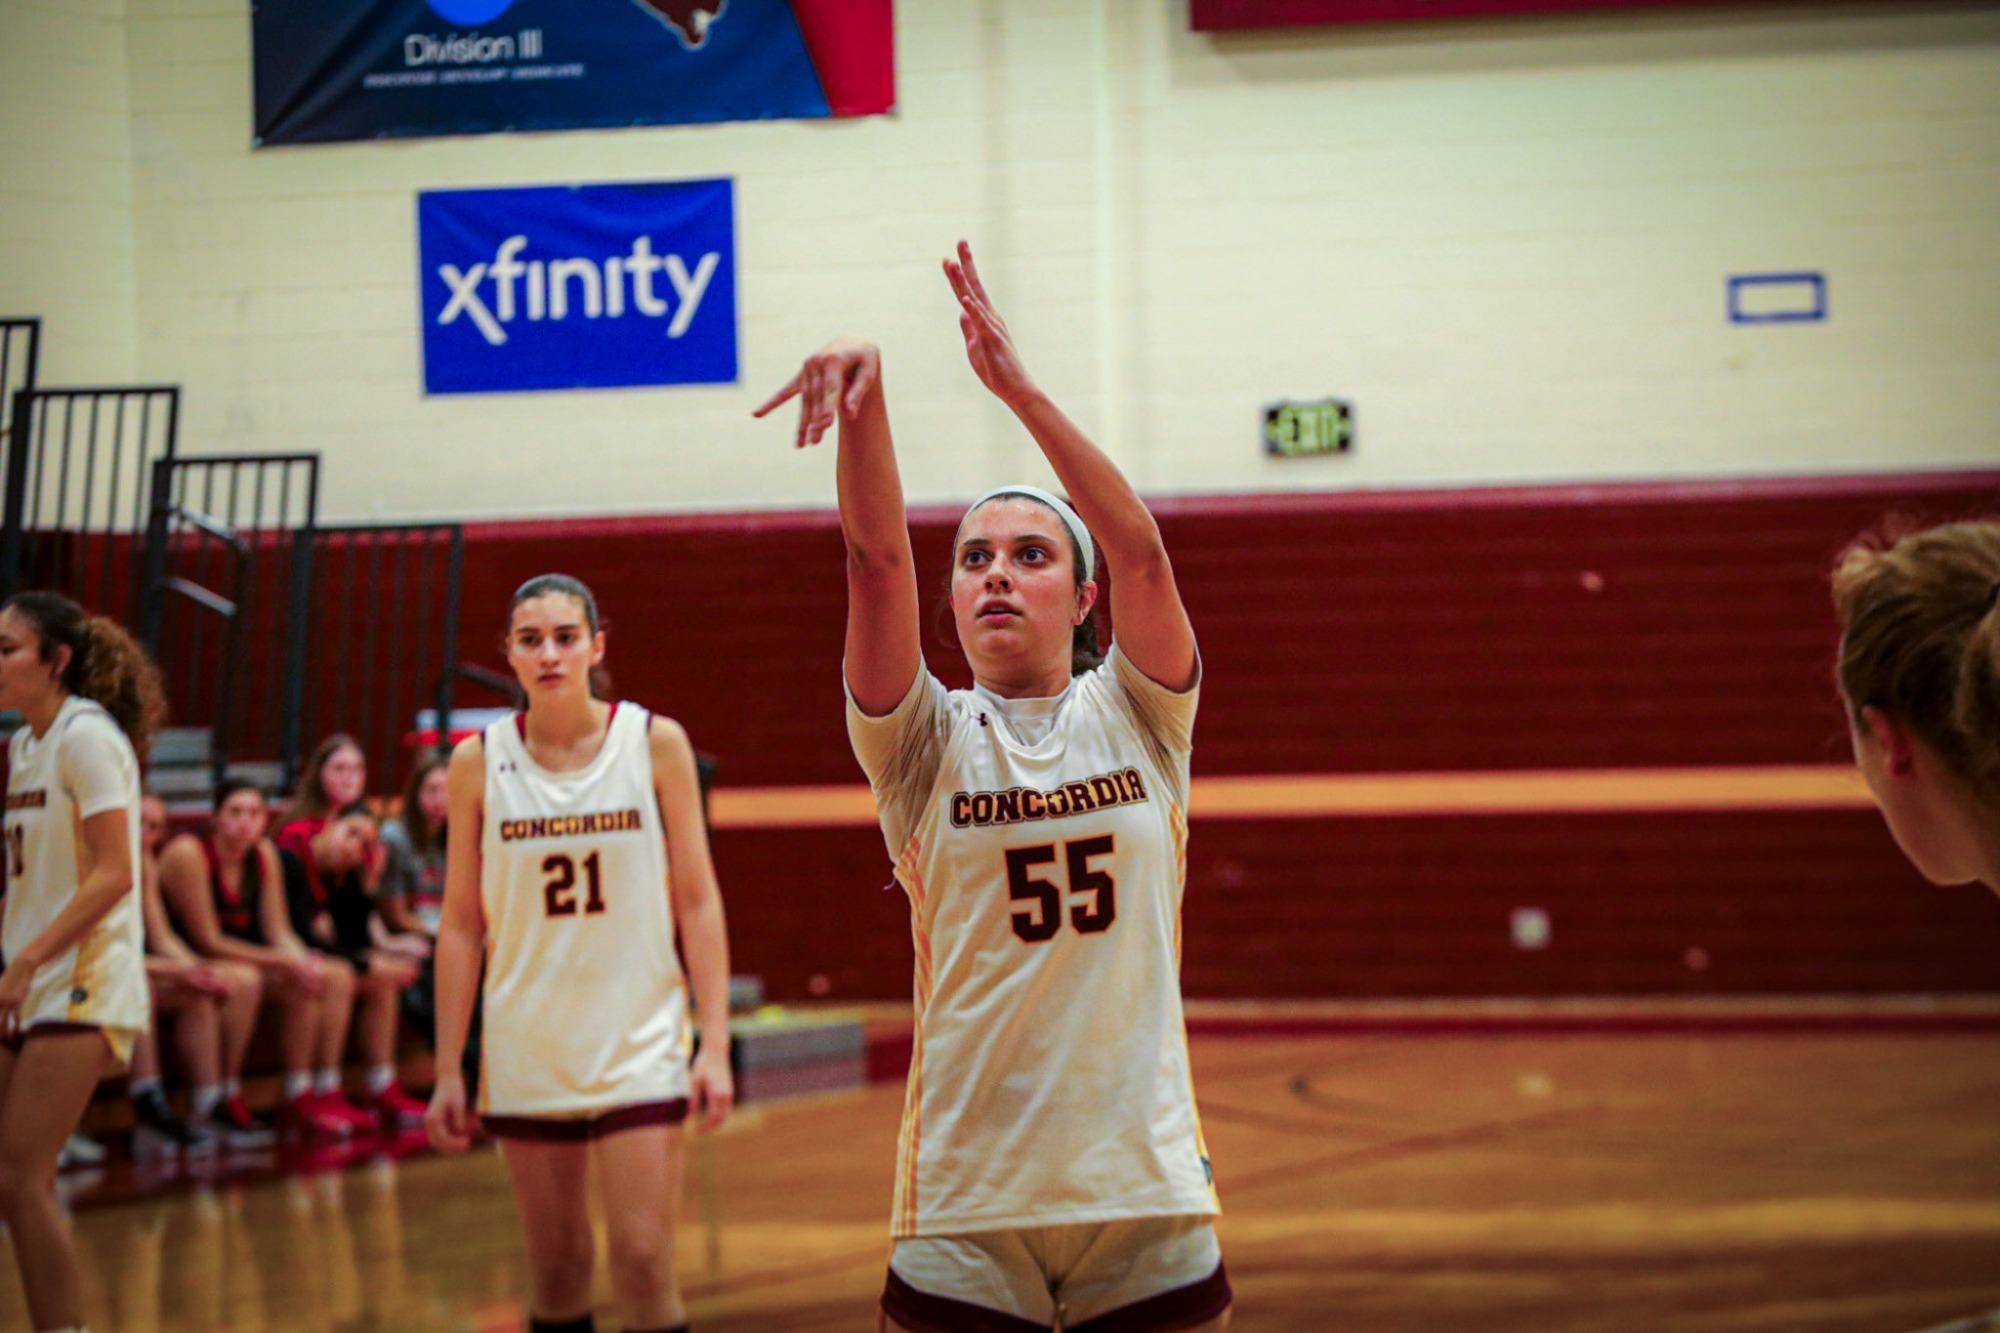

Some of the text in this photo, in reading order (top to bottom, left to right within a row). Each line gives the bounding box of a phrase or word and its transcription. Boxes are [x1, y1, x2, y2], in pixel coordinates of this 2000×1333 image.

[404, 29, 543, 66] Division III
[437, 234, 721, 346] xfinity
[501, 809, 641, 841] CONCORDIA
[950, 765, 1149, 828] CONCORDIA
[541, 849, 606, 918] 21
[1003, 833, 1116, 943] 55
